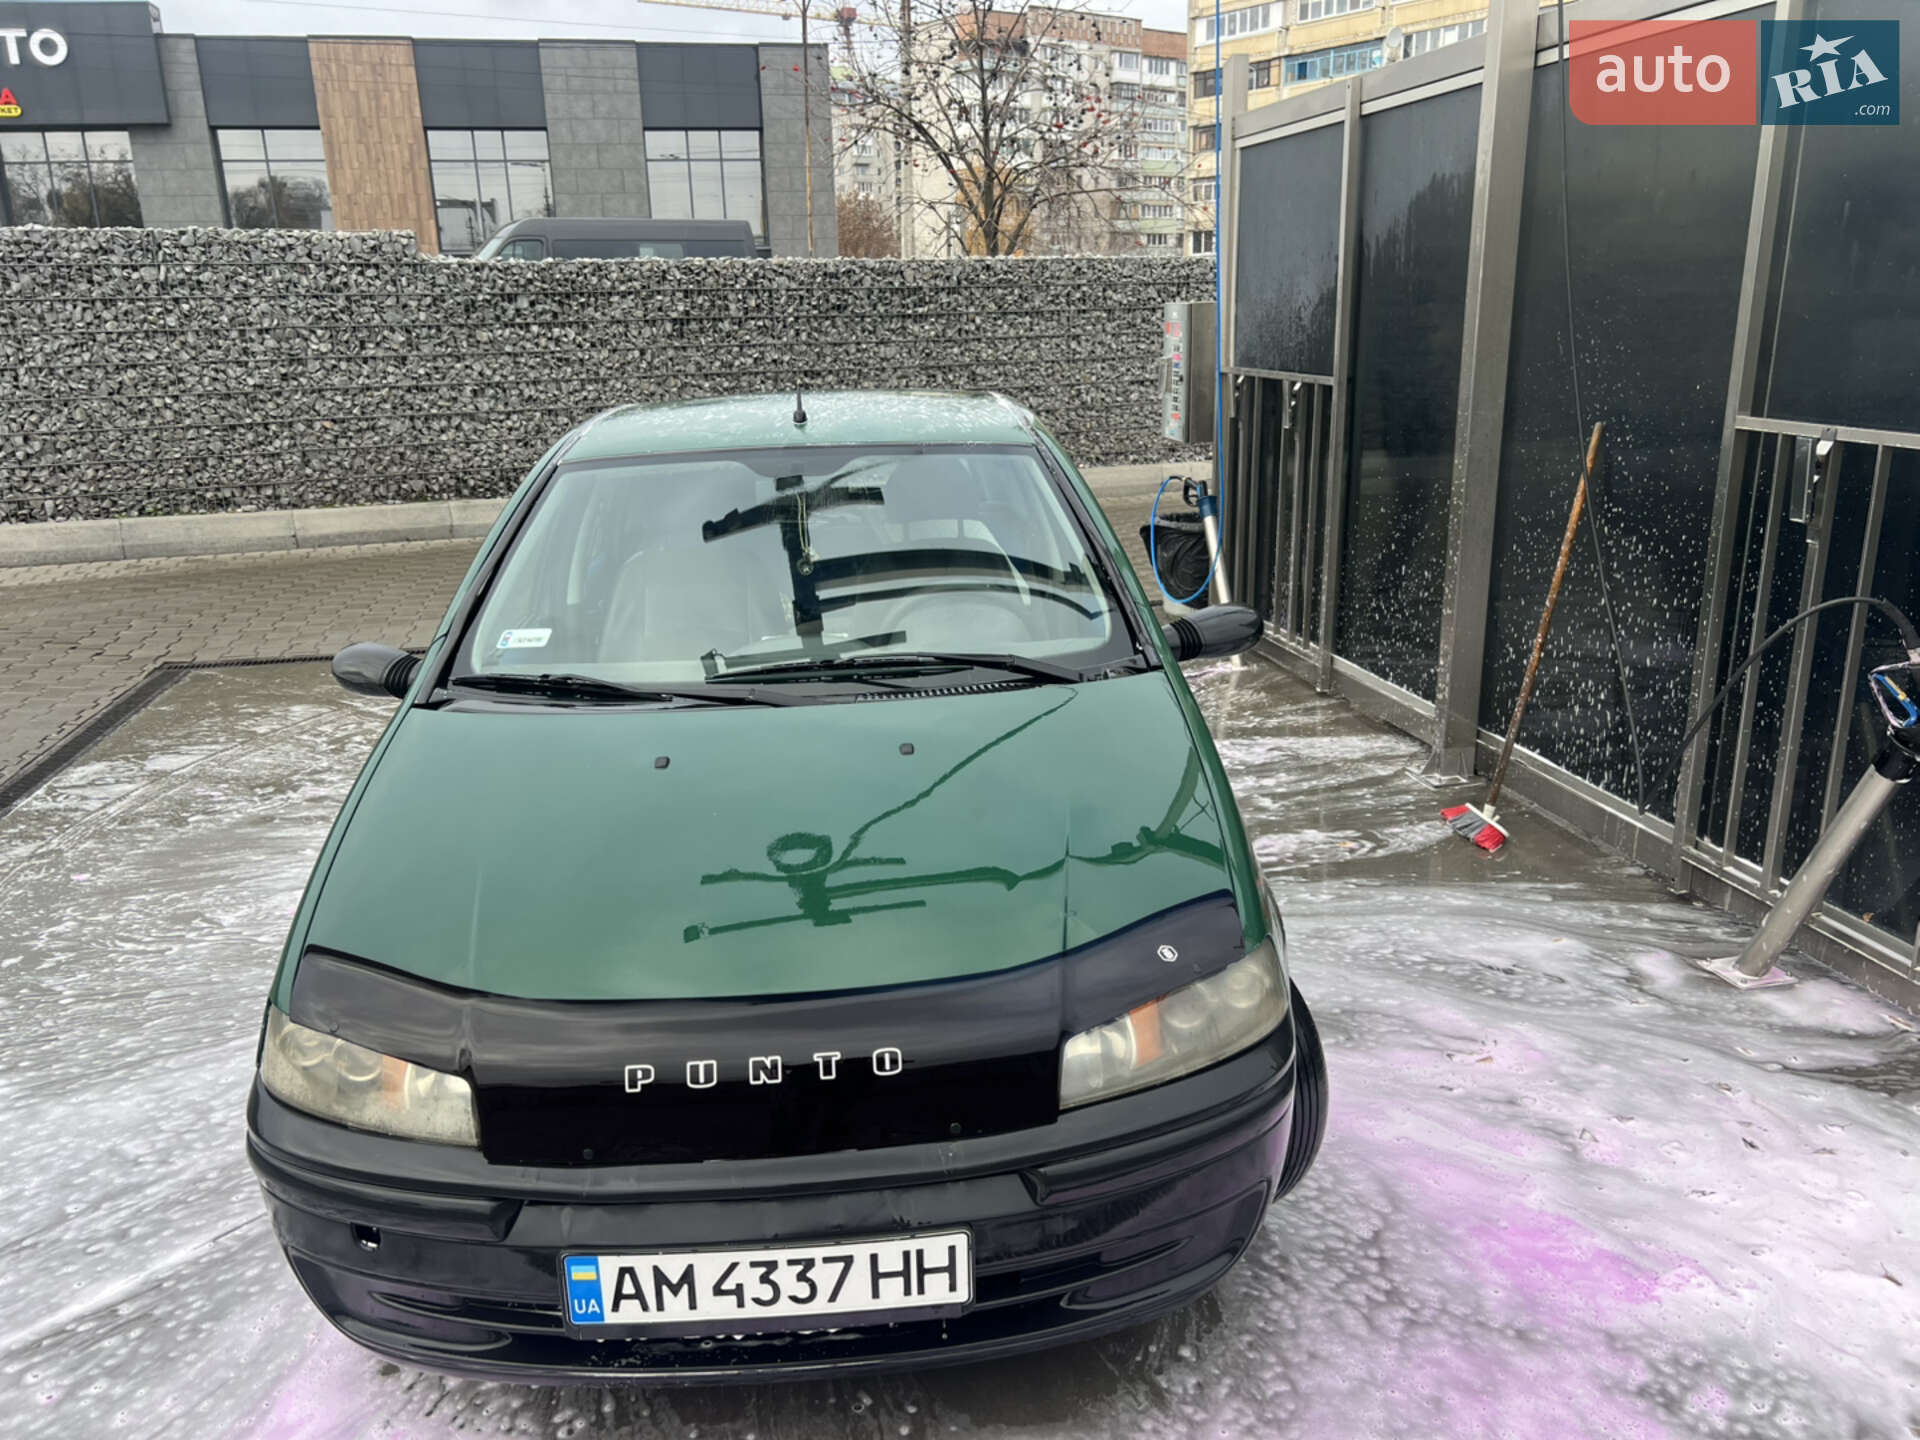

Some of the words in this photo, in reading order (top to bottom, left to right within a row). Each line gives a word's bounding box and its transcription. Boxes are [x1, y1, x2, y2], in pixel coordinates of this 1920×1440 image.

[624, 1047, 902, 1093] PUNTO
[611, 1263, 698, 1313] AM
[712, 1254, 855, 1309] 4337
[869, 1244, 958, 1300] HH
[574, 1301, 600, 1315] UA
